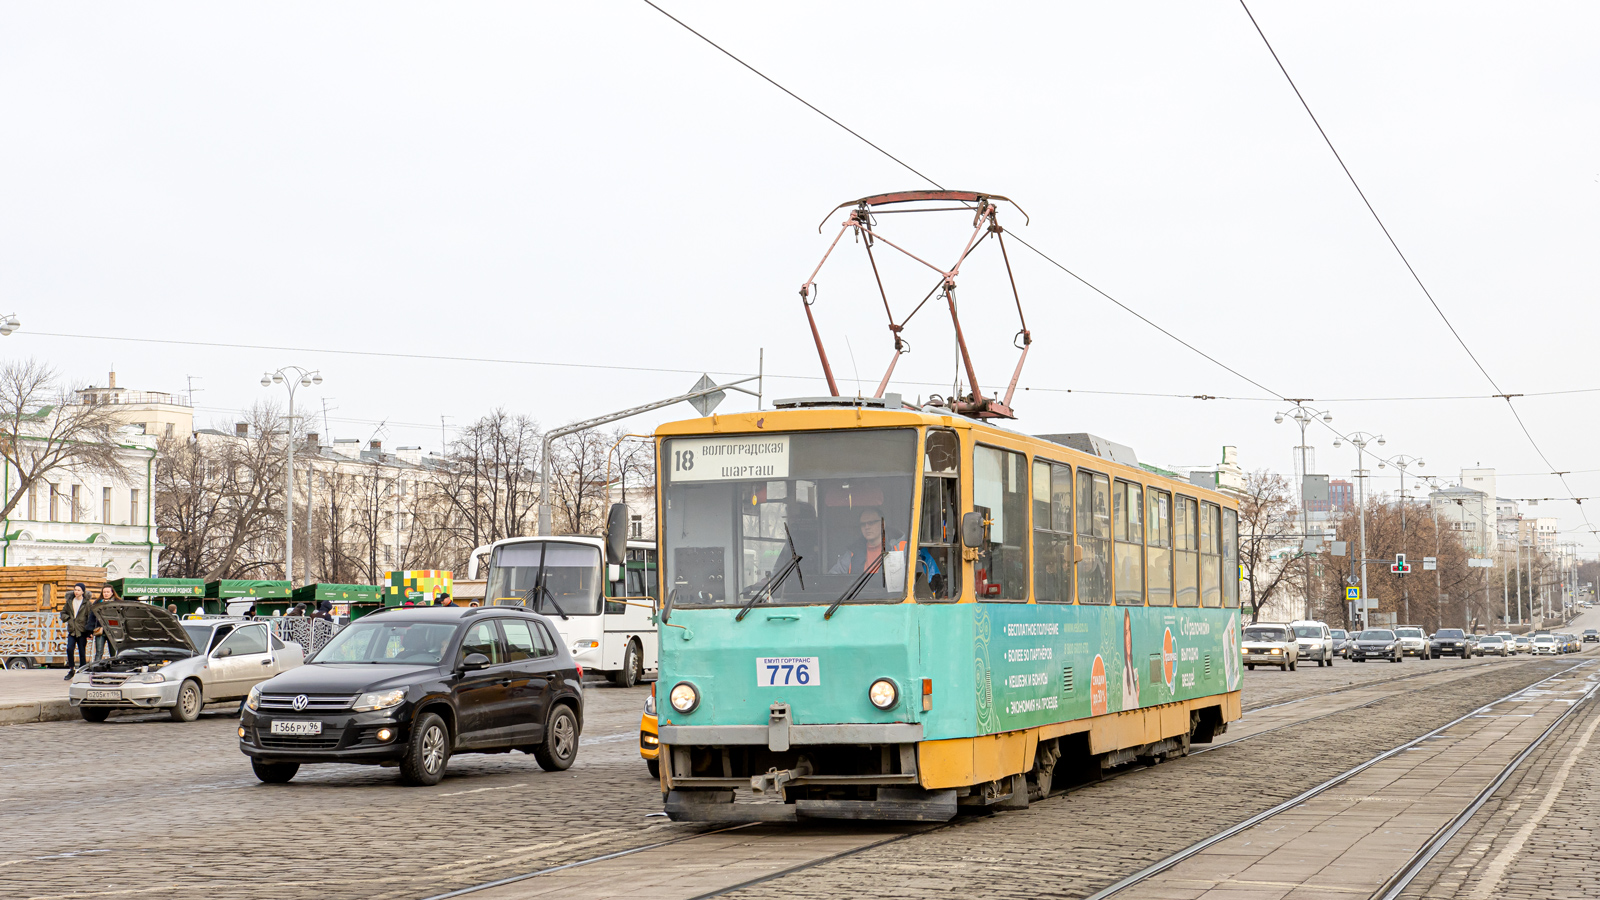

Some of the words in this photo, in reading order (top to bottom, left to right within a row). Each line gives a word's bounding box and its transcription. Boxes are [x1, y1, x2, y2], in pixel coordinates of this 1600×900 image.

[675, 450, 694, 471] 18
[159, 586, 177, 594] ПОКУПАЙ
[1008, 623, 1037, 636] БЕСПЛАТНОЕ
[1037, 623, 1059, 635] ПОЛУЧЕНИЕ
[27, 641, 67, 652] BURG
[1008, 649, 1023, 662] БОЛЕЕ
[1024, 649, 1030, 661] 50
[1030, 644, 1053, 660] ПАРТНЁРОВ
[766, 664, 810, 685] 776
[1009, 674, 1027, 688] КЕШБЭК
[1028, 674, 1032, 687] И
[1032, 673, 1048, 686] БОНУСЫ
[1010, 700, 1036, 714] ЭКОНОМИЯ
[1036, 699, 1041, 710] НА
[1041, 696, 1059, 710] ПРОЕЗДЕ
[310, 722, 319, 730] 96
